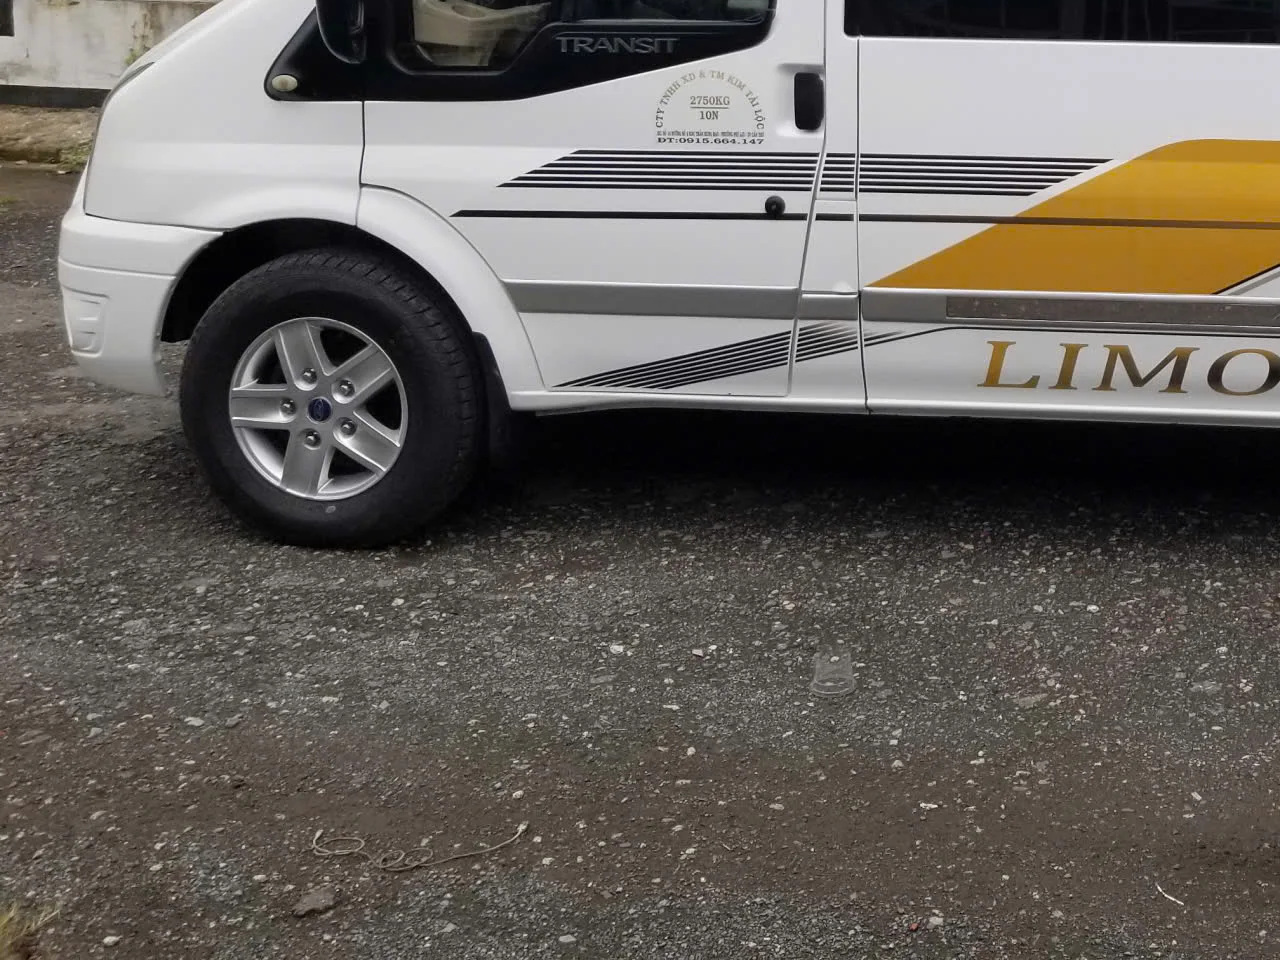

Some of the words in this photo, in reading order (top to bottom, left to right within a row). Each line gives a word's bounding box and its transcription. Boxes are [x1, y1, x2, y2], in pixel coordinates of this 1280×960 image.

[556, 37, 679, 53] TRANSIT
[681, 72, 696, 85] XD
[699, 70, 706, 79] &
[710, 70, 725, 80] TM
[727, 75, 746, 91] KIM
[660, 81, 681, 106] TNHH
[690, 96, 730, 106] 2750KG
[656, 107, 665, 128] CTY
[699, 110, 719, 120] 10N
